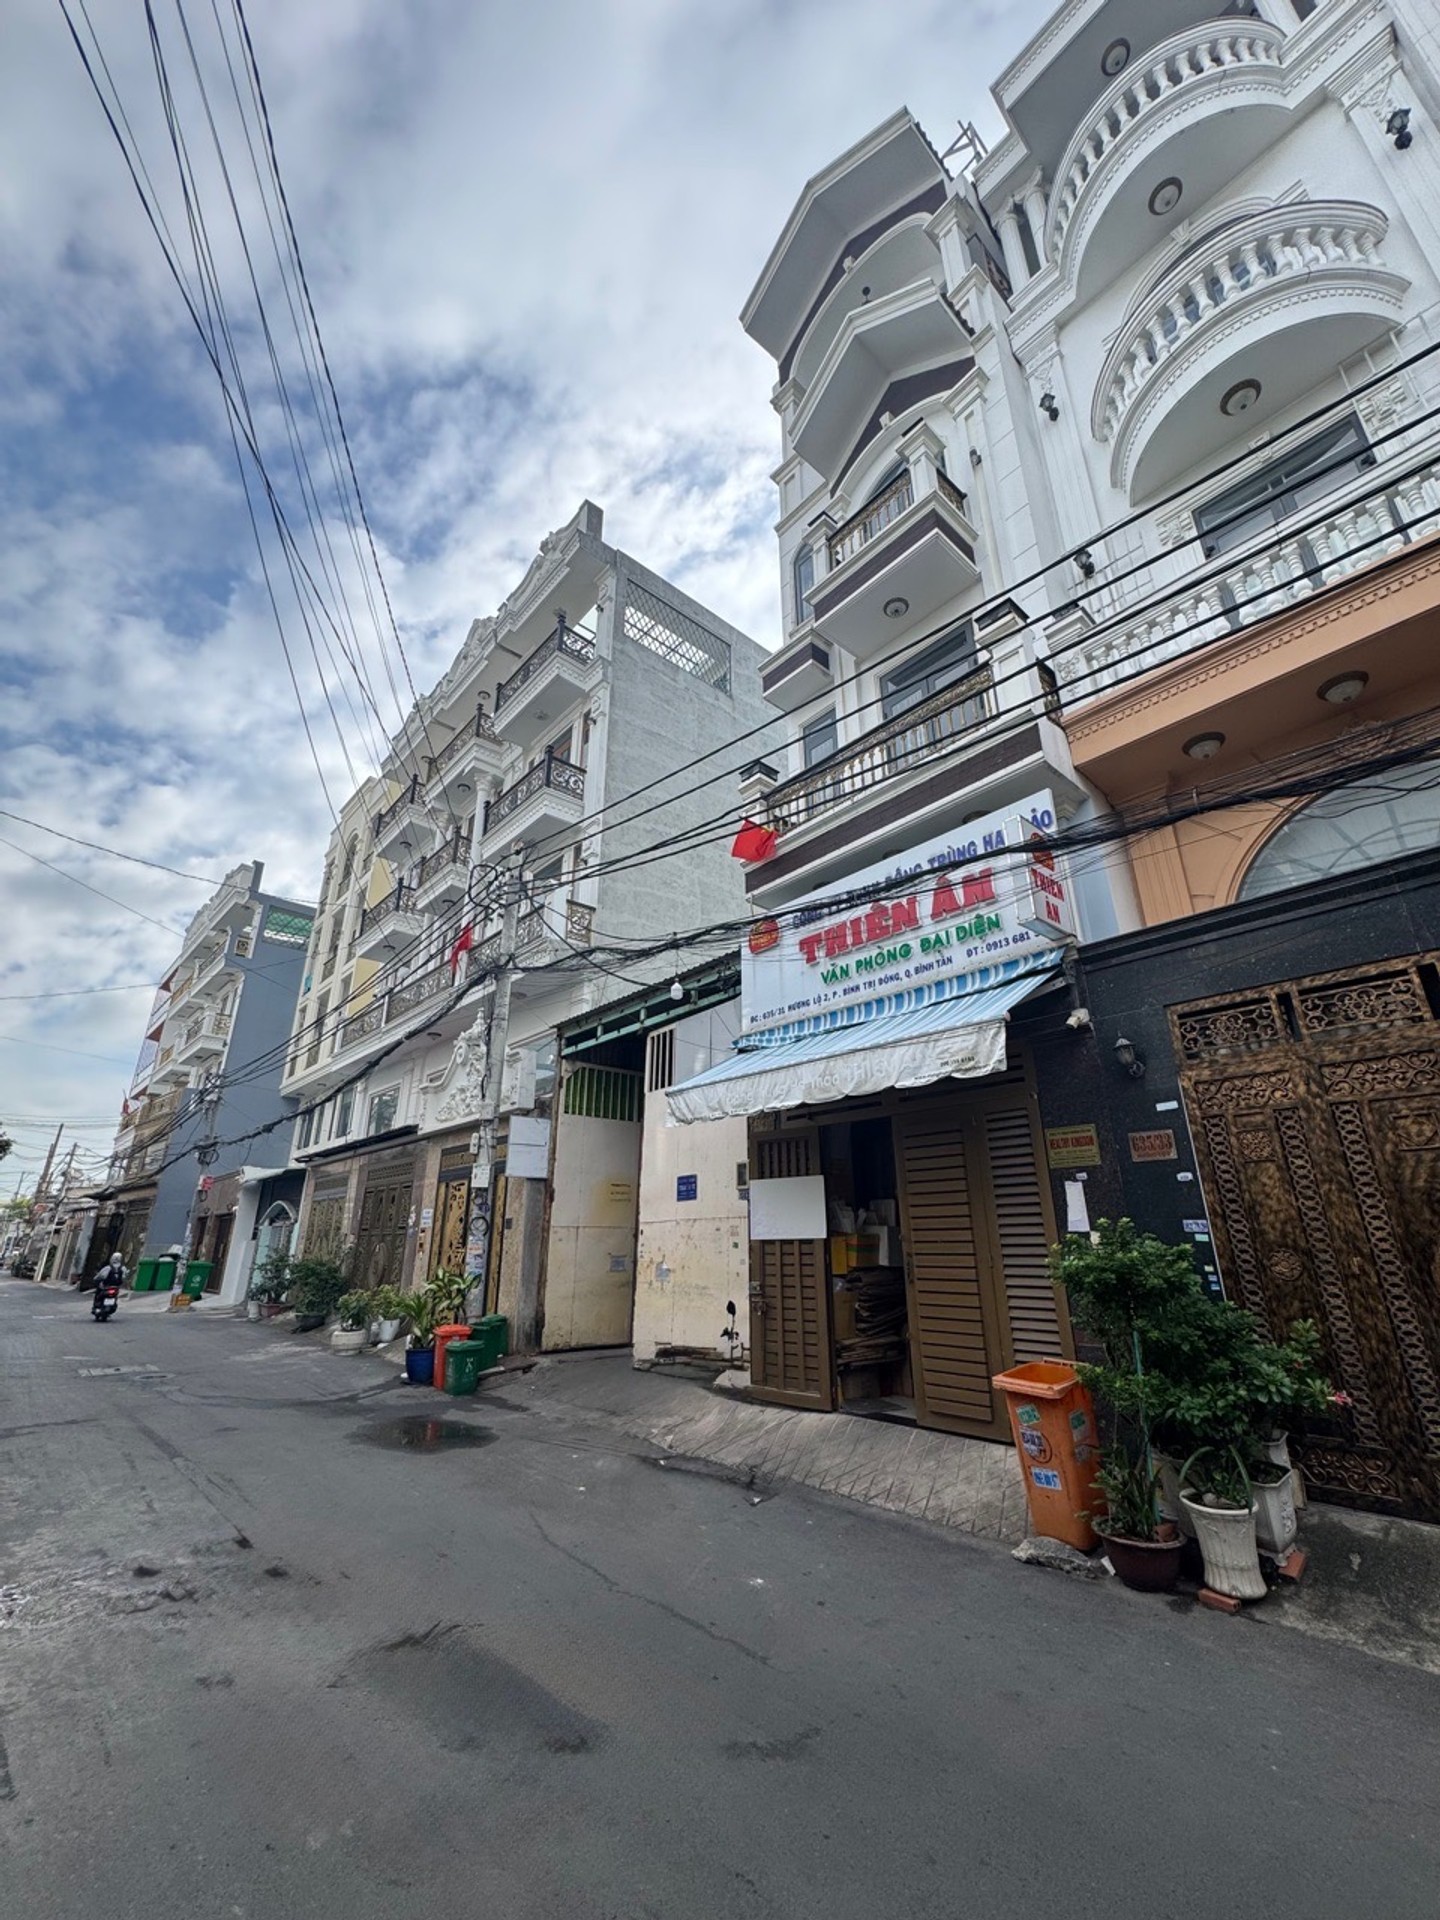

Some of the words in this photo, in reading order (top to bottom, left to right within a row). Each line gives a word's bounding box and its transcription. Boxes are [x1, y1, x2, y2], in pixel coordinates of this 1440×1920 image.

[799, 897, 921, 965] THIÊN
[931, 867, 996, 921] ÂN
[985, 936, 1010, 953] 0913
[1012, 931, 1032, 945] 681
[821, 963, 849, 985] VĂN
[855, 943, 913, 974] PHÒNG
[920, 930, 950, 954] ĐẠI
[956, 913, 1001, 940] DIỆN
[813, 993, 822, 1006] LỘ
[843, 984, 861, 996] BÌNH
[863, 979, 876, 991] TRỊ
[914, 962, 935, 976] BÌNH
